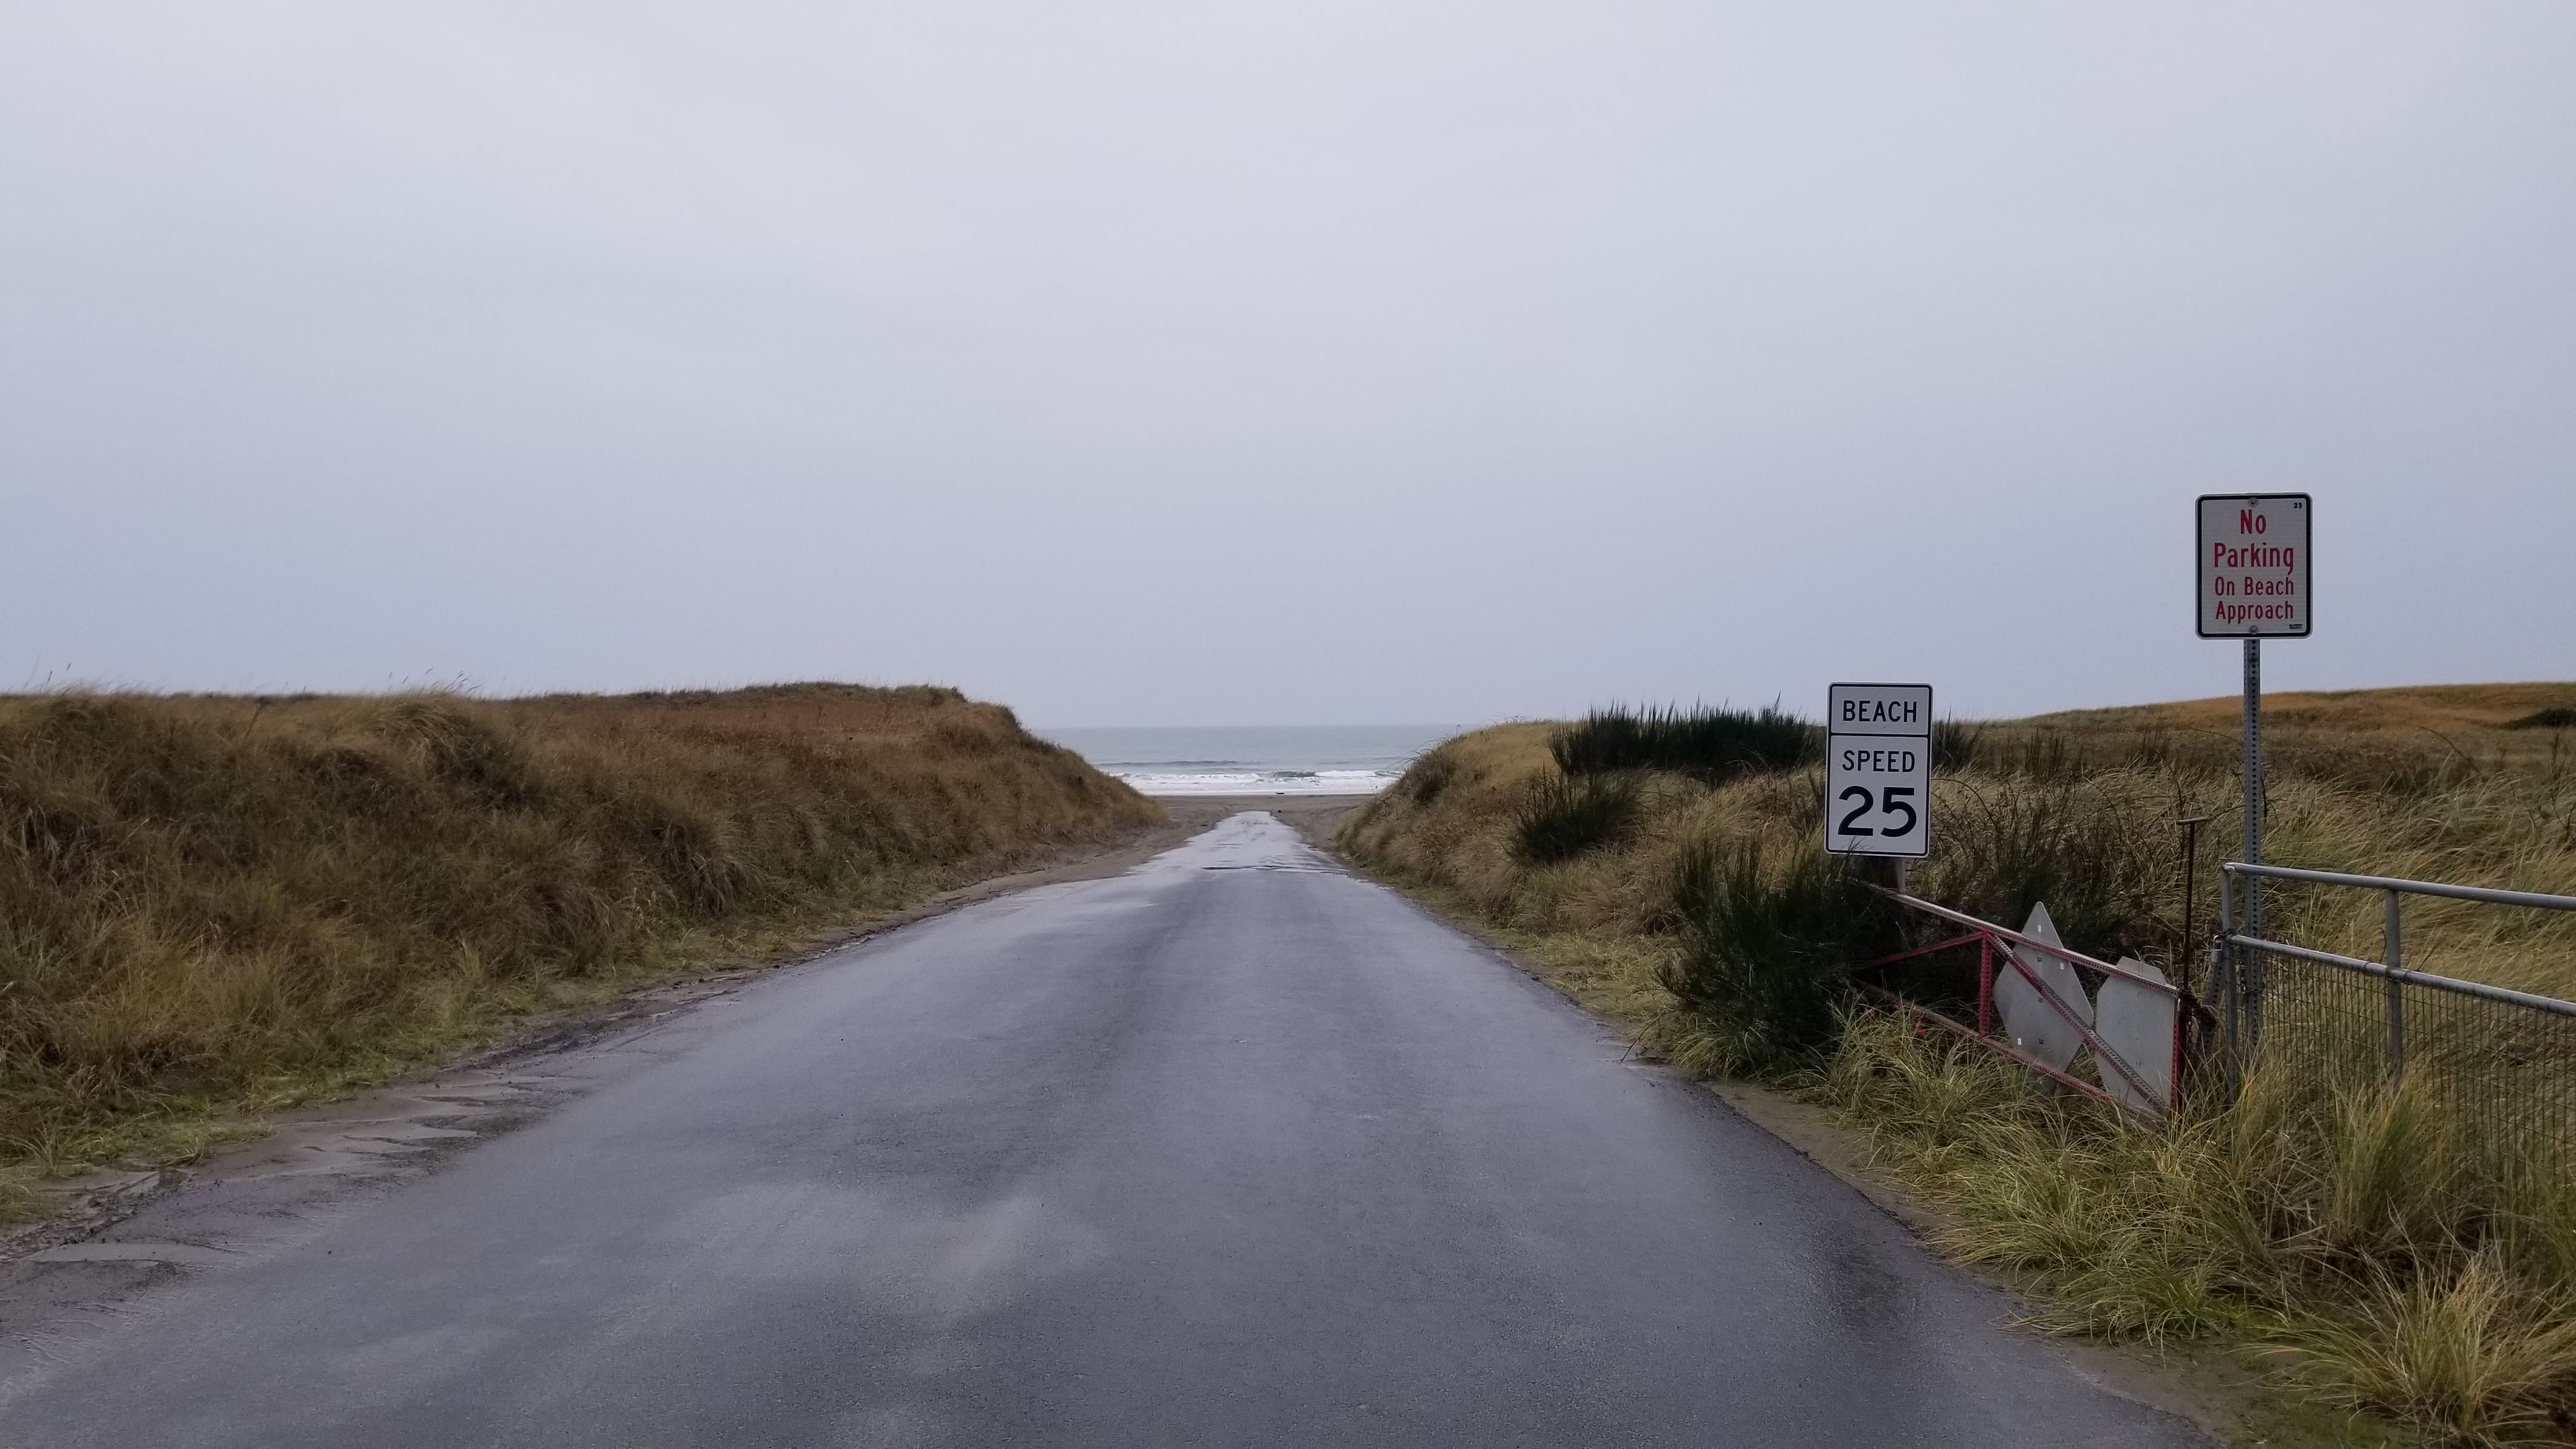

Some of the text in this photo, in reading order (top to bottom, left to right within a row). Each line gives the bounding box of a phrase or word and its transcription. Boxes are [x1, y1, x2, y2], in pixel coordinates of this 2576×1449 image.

[2241, 509, 2267, 534] No
[2214, 542, 2294, 575] Parking
[2214, 576, 2294, 595] On Beach
[2215, 601, 2294, 624] Approach
[1843, 700, 1917, 723] BEACH
[1842, 750, 1915, 772] SPEED
[1837, 785, 1917, 838] 25
